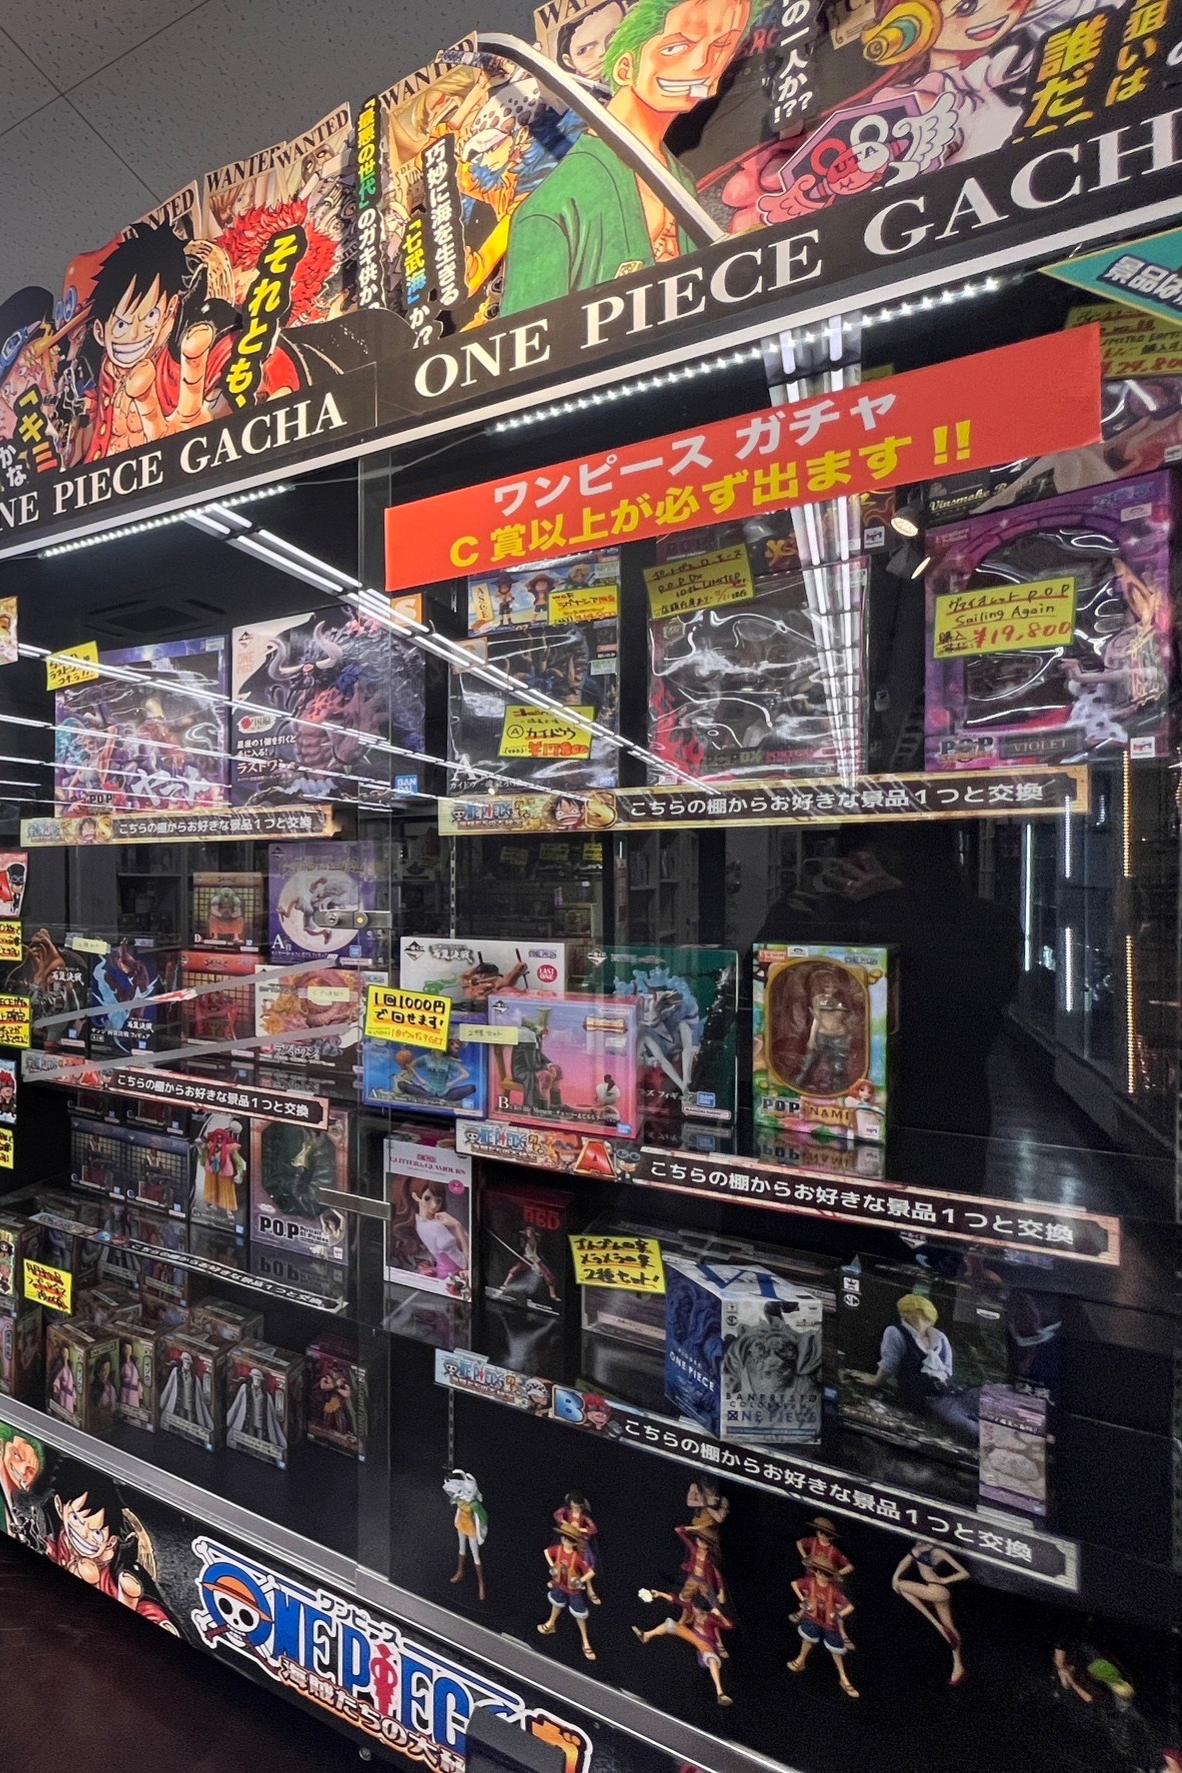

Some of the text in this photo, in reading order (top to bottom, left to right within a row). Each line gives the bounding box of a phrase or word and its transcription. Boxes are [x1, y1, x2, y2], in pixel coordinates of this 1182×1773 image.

[276, 109, 349, 169] WANTED
[834, 145, 879, 173] UTA
[424, 139, 460, 306] 巧妙に海を生きる
[415, 106, 1182, 399] ONE PIECE GACH
[225, 230, 299, 408] それとも、
[51, 449, 164, 519] PIECE
[179, 390, 349, 476] GACHA
[492, 387, 897, 518] ワンピース ガチャ
[448, 419, 971, 568] C 賞以上が必ず出ます !!
[955, 603, 1055, 628] Sailing Again
[972, 620, 1072, 649] ¥19,800
[1012, 738, 1068, 753] VIOLET
[584, 791, 617, 829] S
[630, 781, 1043, 819] こちらの棚からお好きな景品1つと交換
[374, 991, 447, 1015] 1回1000円
[117, 1074, 310, 1119] こちらの棚からお好きな景品1つと交換
[498, 1095, 510, 1111] B
[809, 1106, 850, 1123] NAMI
[574, 1140, 616, 1178] A
[523, 1207, 561, 1231] RED
[649, 1159, 1075, 1246] こちらの棚からお好きな景品1つと交換
[259, 1214, 299, 1240] P.O.P
[669, 1351, 715, 1393] ONE PIECE
[553, 1385, 586, 1425] B
[624, 1420, 1033, 1563] こちらの棚からお好きな景品1つと交換
[201, 1560, 334, 1686] ONE
[320, 1591, 402, 1645] ワンピース
